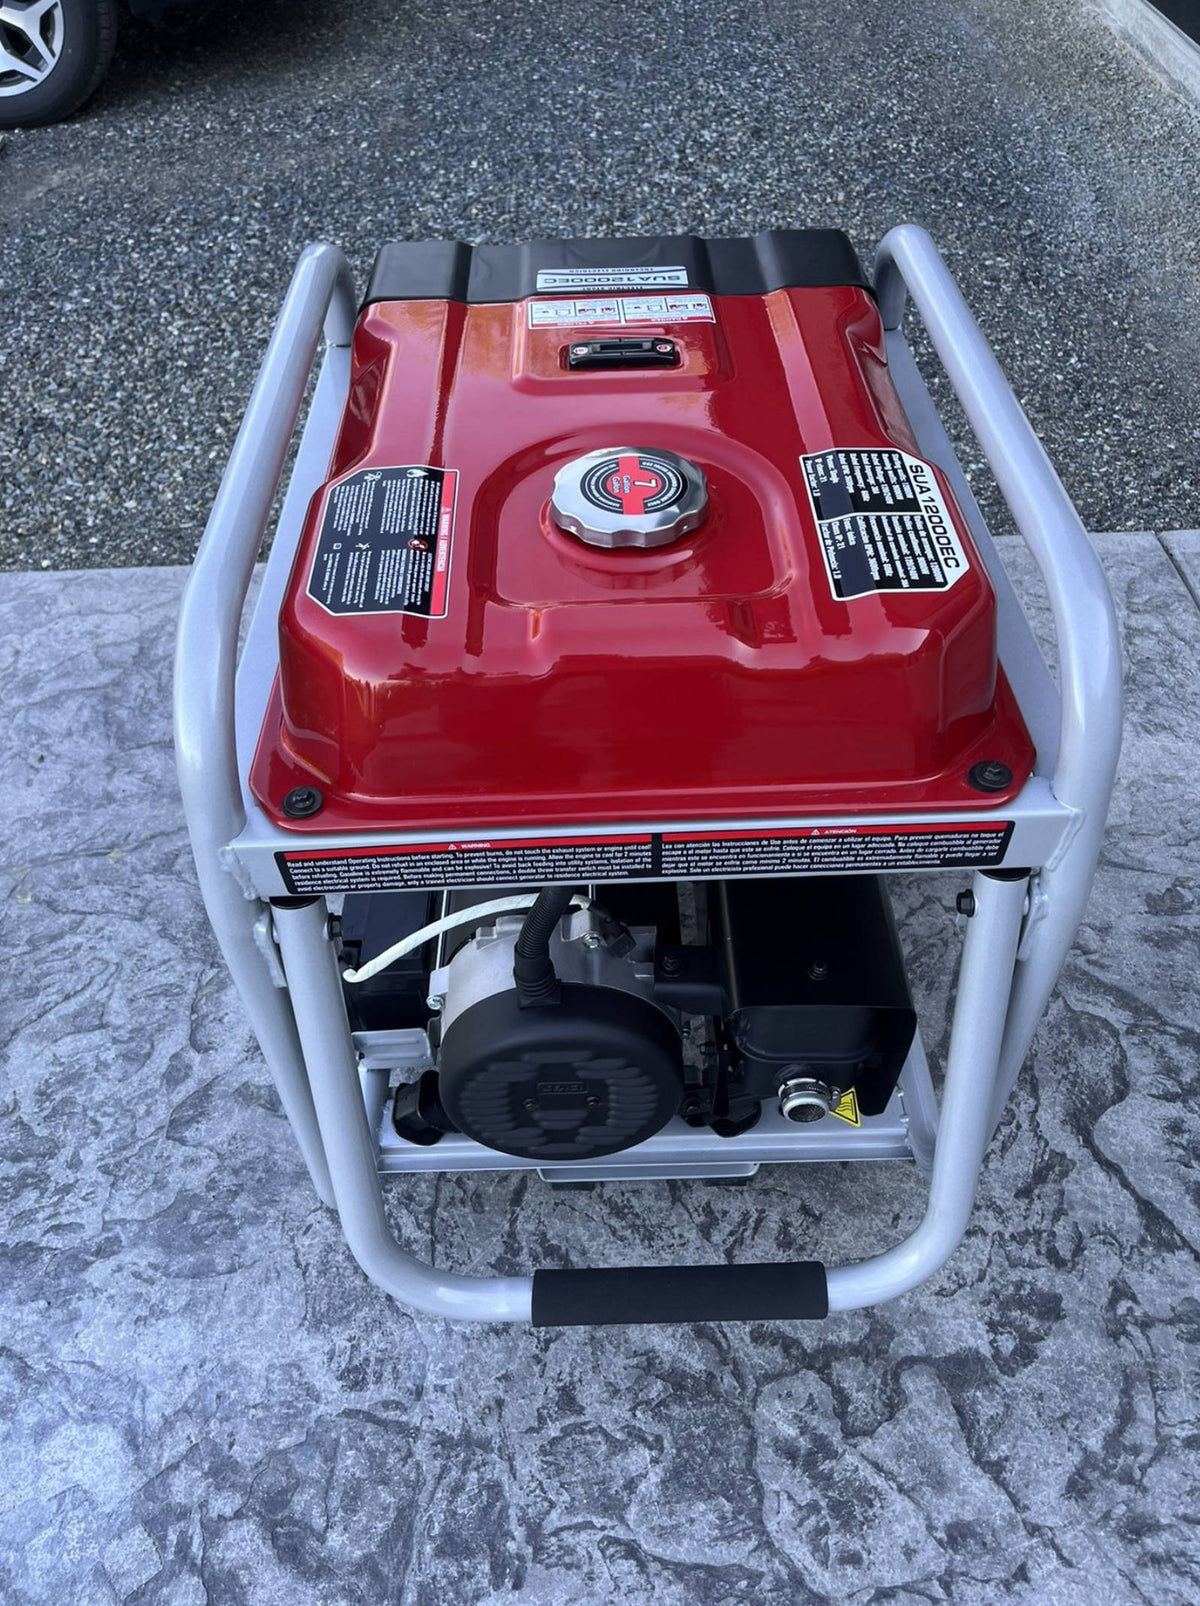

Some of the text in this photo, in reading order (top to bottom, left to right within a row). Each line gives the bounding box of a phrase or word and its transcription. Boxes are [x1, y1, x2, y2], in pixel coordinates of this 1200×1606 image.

[543, 275, 681, 285] SUA12000EC
[622, 475, 631, 493] Gallon
[635, 480, 657, 488] 7
[909, 464, 960, 568] SUA12000EC
